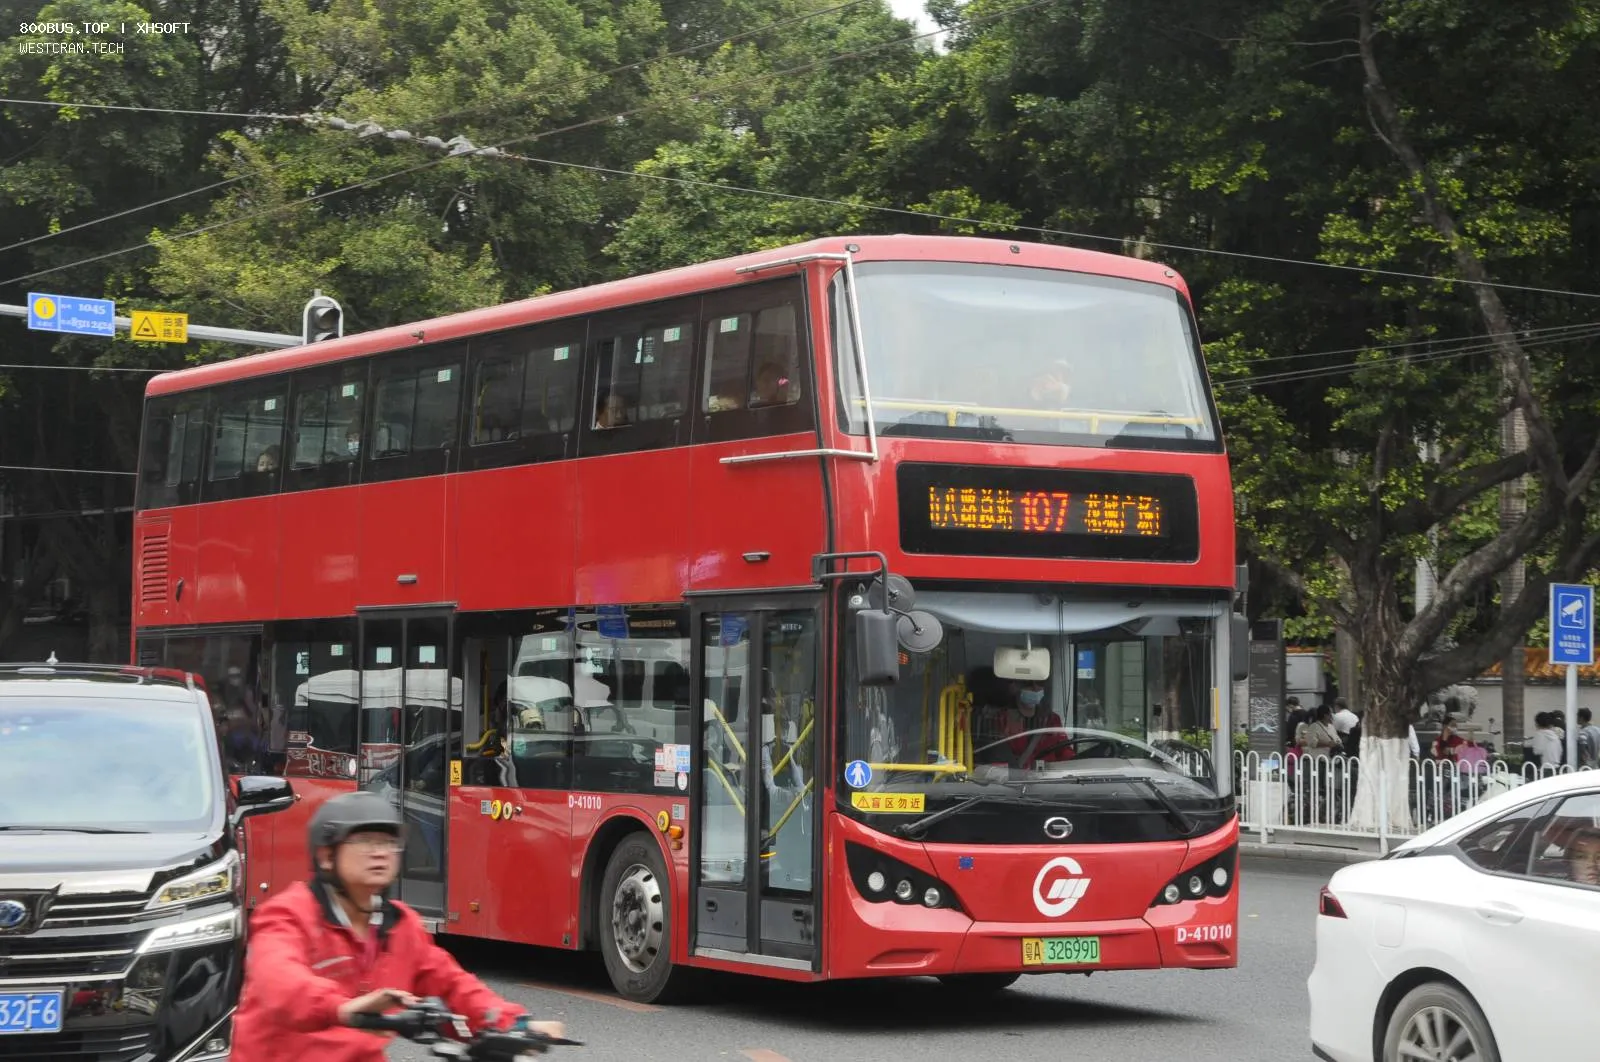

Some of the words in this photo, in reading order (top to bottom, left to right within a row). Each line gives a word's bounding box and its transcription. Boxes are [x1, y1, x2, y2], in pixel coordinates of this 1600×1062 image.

[1020, 491, 1069, 532] 107
[568, 795, 602, 810] D-41010
[871, 796, 921, 810] 盲区勿近
[1177, 923, 1232, 942] D-41010
